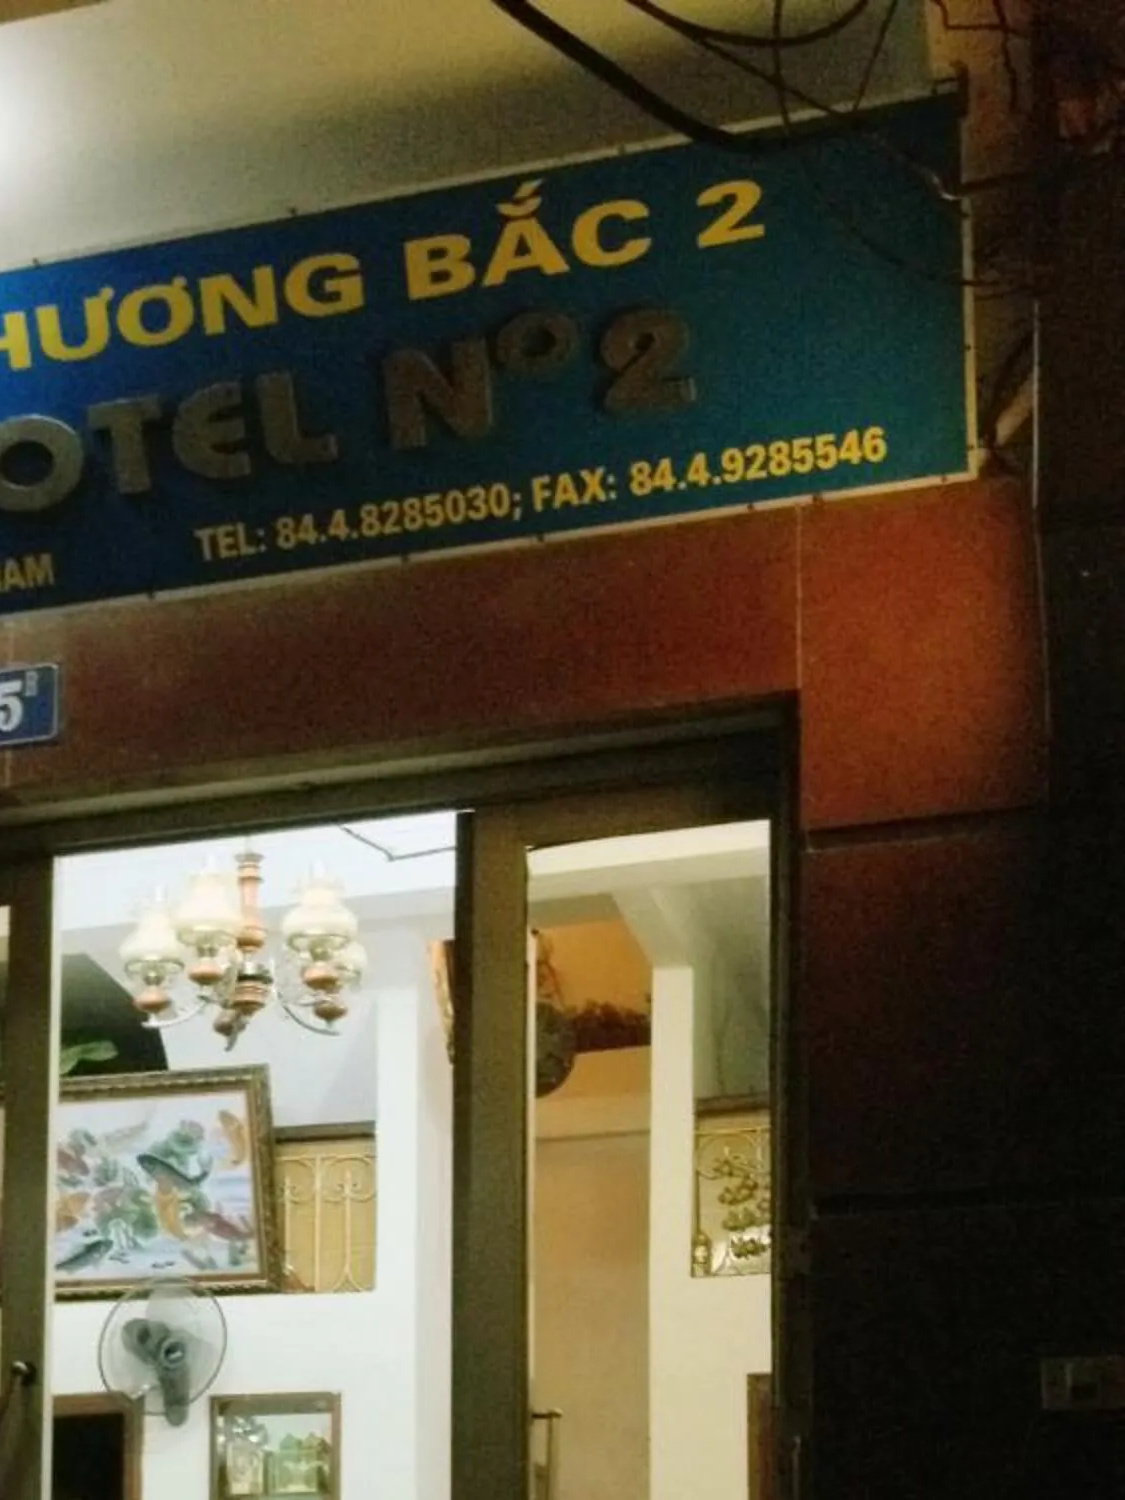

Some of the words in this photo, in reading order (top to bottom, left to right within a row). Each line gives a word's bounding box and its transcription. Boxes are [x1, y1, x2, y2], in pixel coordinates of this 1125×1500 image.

[402, 178, 653, 301] BẮC
[696, 178, 765, 249] 2
[599, 308, 697, 415] 2
[194, 523, 266, 562] TEL:
[531, 465, 618, 513] FAX:
[629, 425, 888, 498] 84.4.9285546
